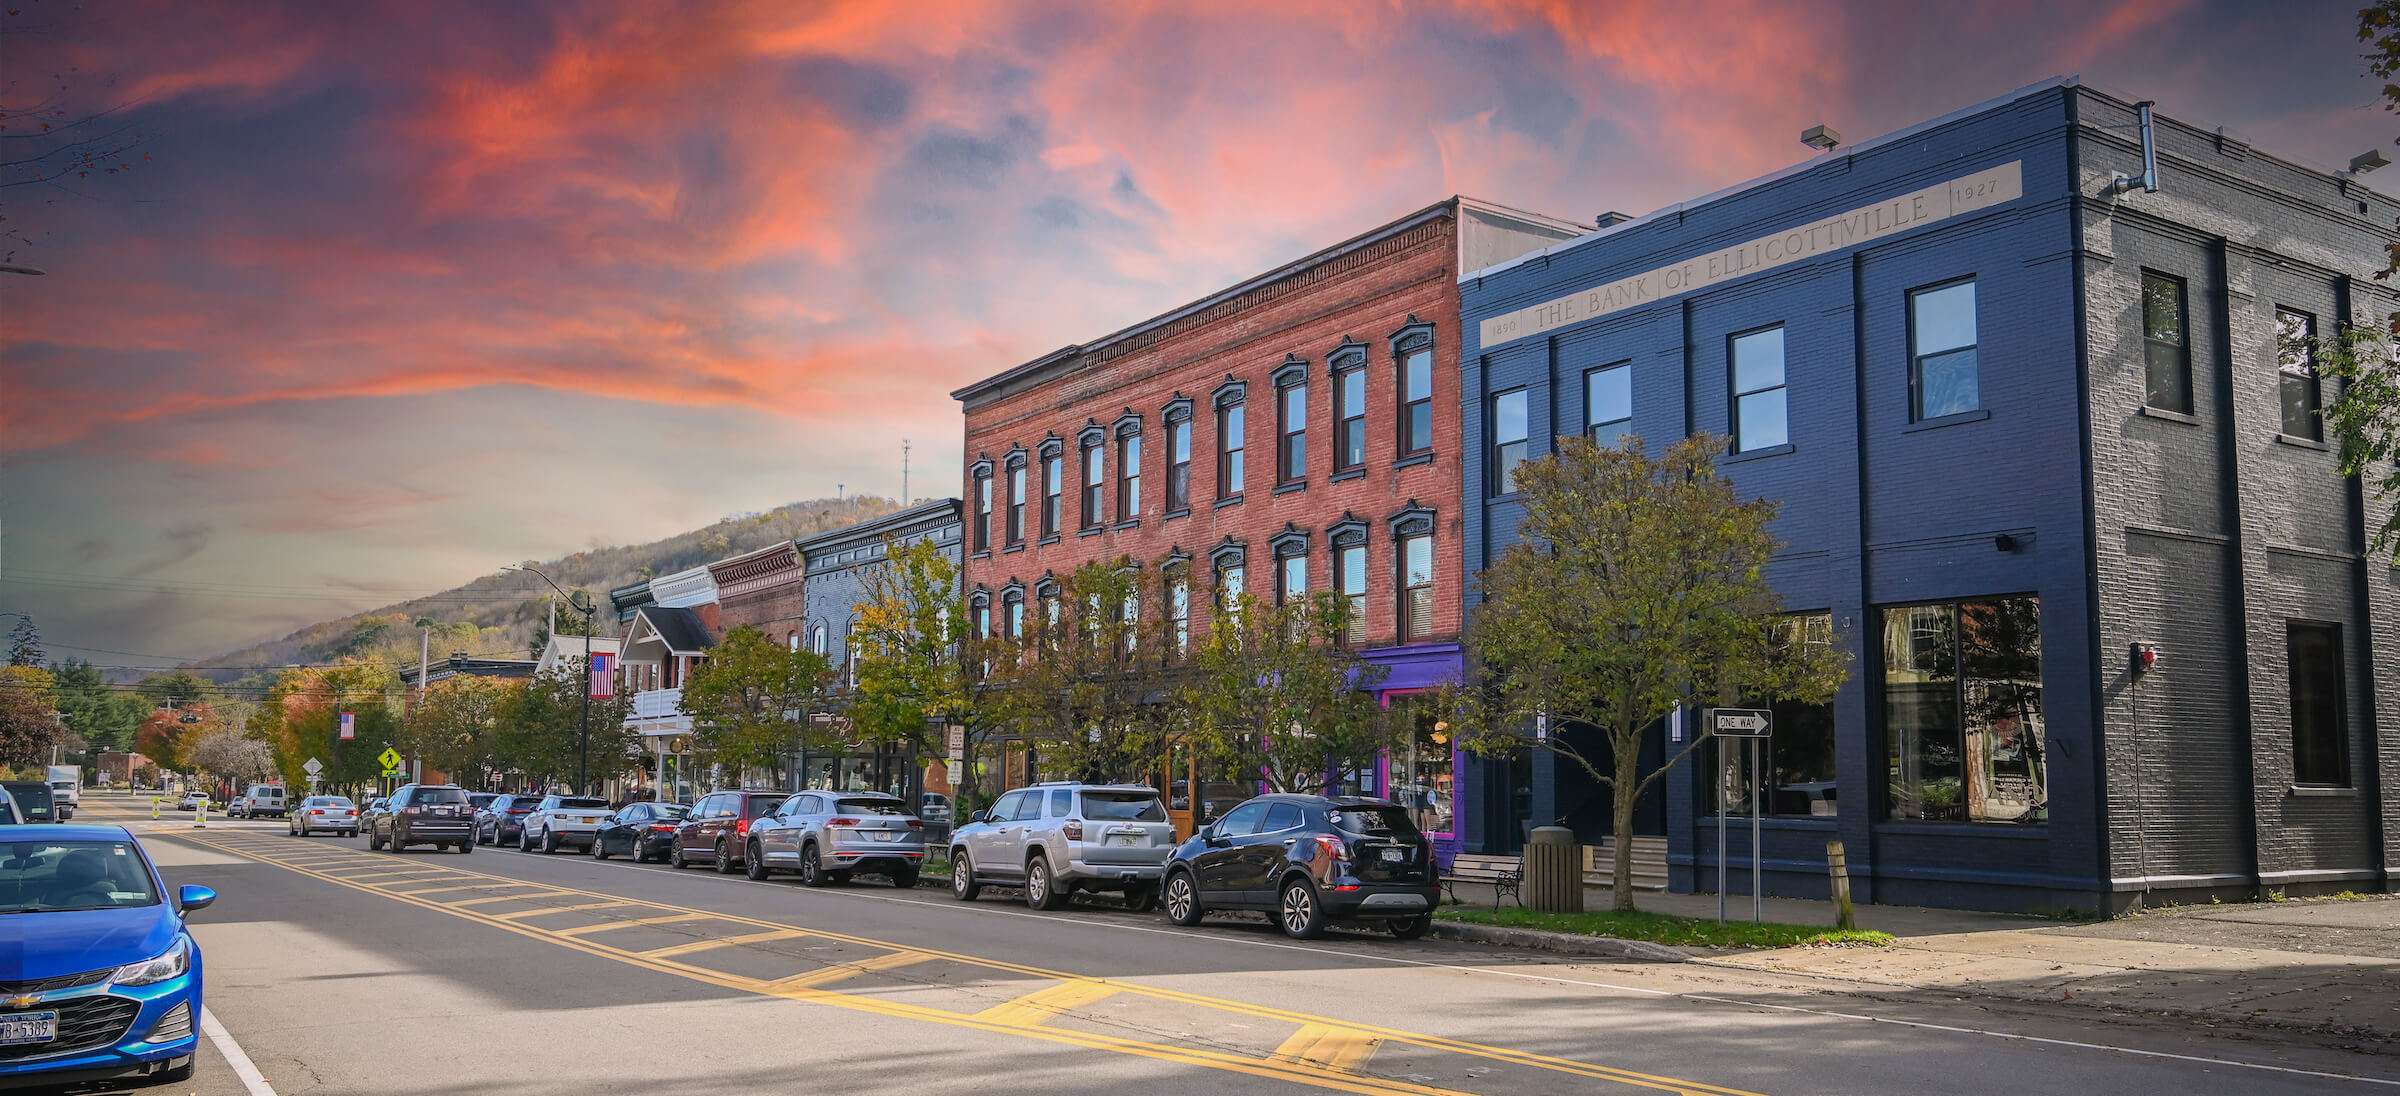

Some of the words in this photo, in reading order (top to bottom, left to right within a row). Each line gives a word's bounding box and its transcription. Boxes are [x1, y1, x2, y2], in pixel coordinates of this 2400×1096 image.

[1492, 321, 1517, 337] 1890
[1536, 300, 1576, 328] THE
[1589, 277, 1650, 314] BANK
[1665, 264, 1694, 290] OF
[1707, 195, 1929, 280] ELLICOTTVILLE
[1956, 179, 1999, 203] 1927
[1720, 716, 1736, 728] ONE
[1740, 717, 1756, 728] WAY
